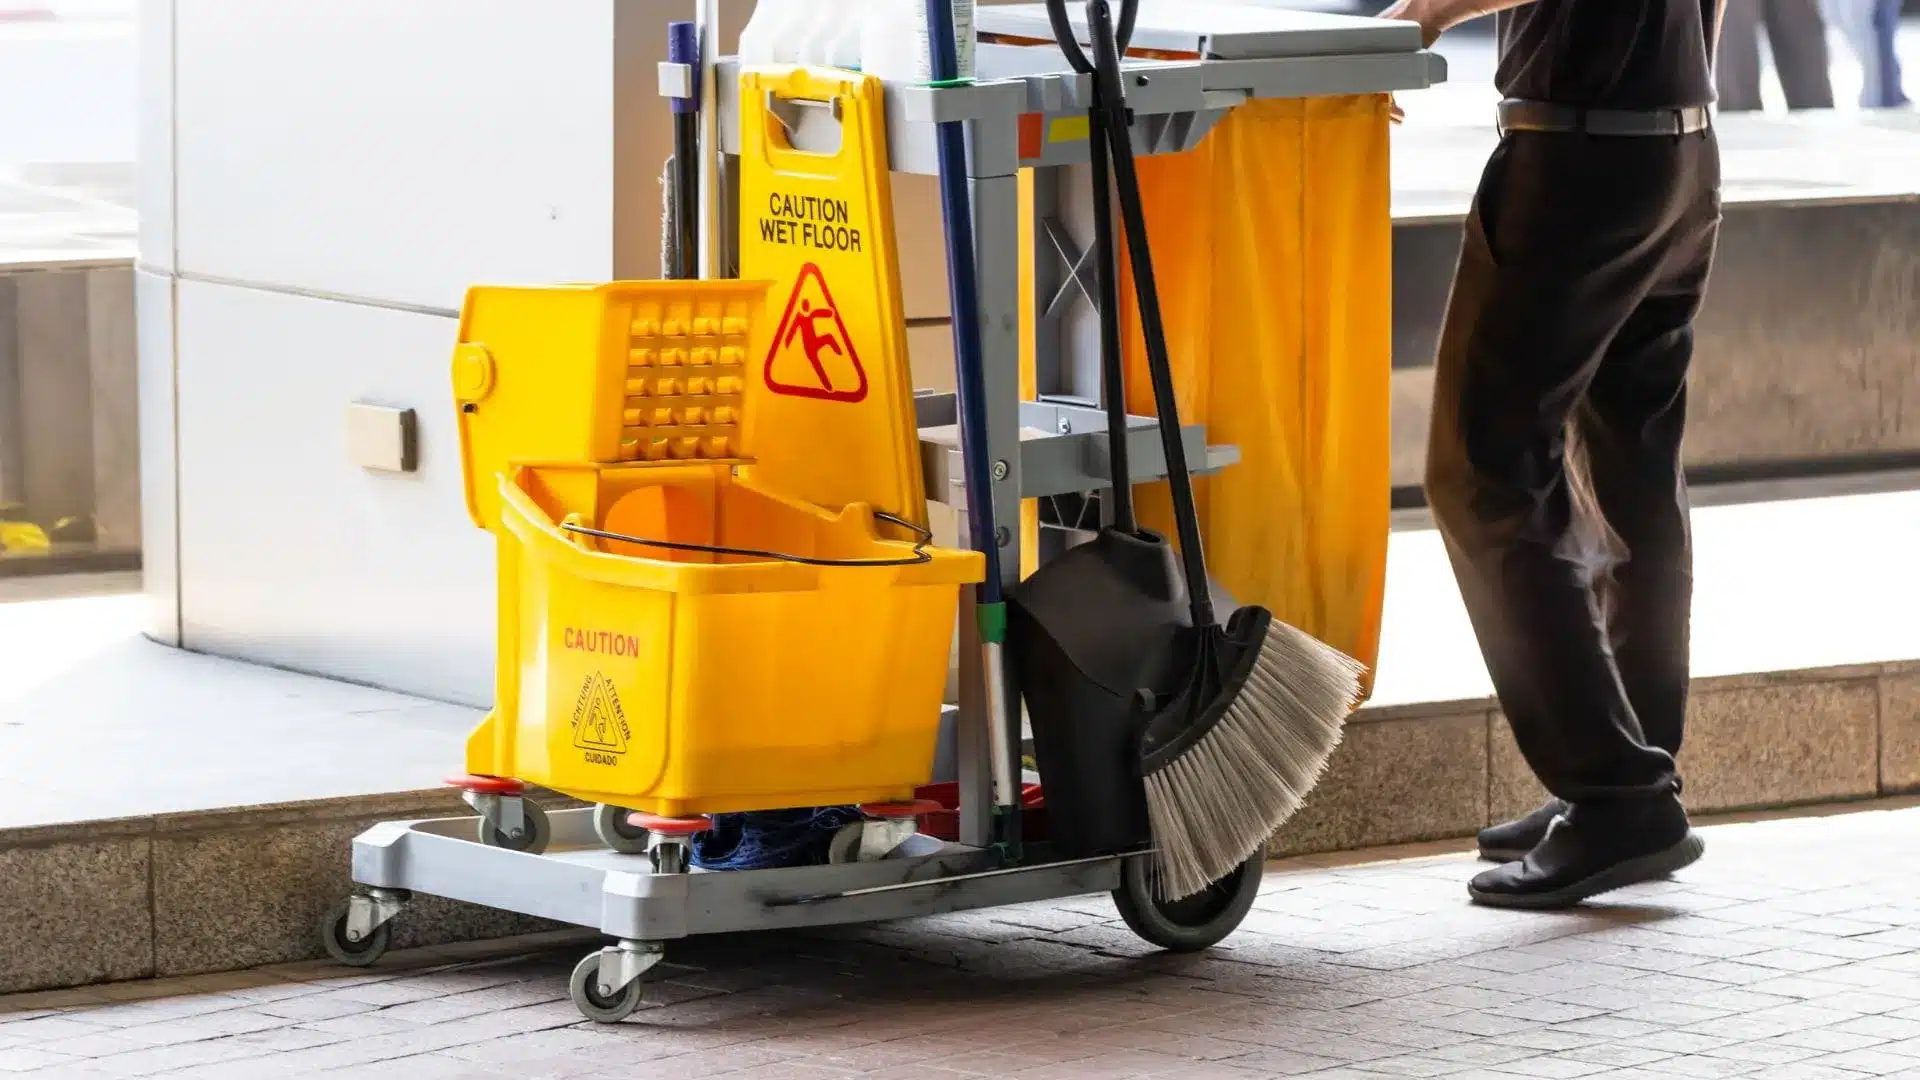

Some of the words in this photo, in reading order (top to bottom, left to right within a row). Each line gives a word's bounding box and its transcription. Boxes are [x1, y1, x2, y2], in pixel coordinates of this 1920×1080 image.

[769, 192, 848, 224] CAUTION
[760, 217, 798, 245] WET
[803, 223, 862, 252] FLOOR
[564, 627, 640, 658] CAUTION
[571, 674, 593, 728] ACHTUNG
[605, 678, 632, 741] ATTENTION
[584, 752, 618, 767] CUIDADO
